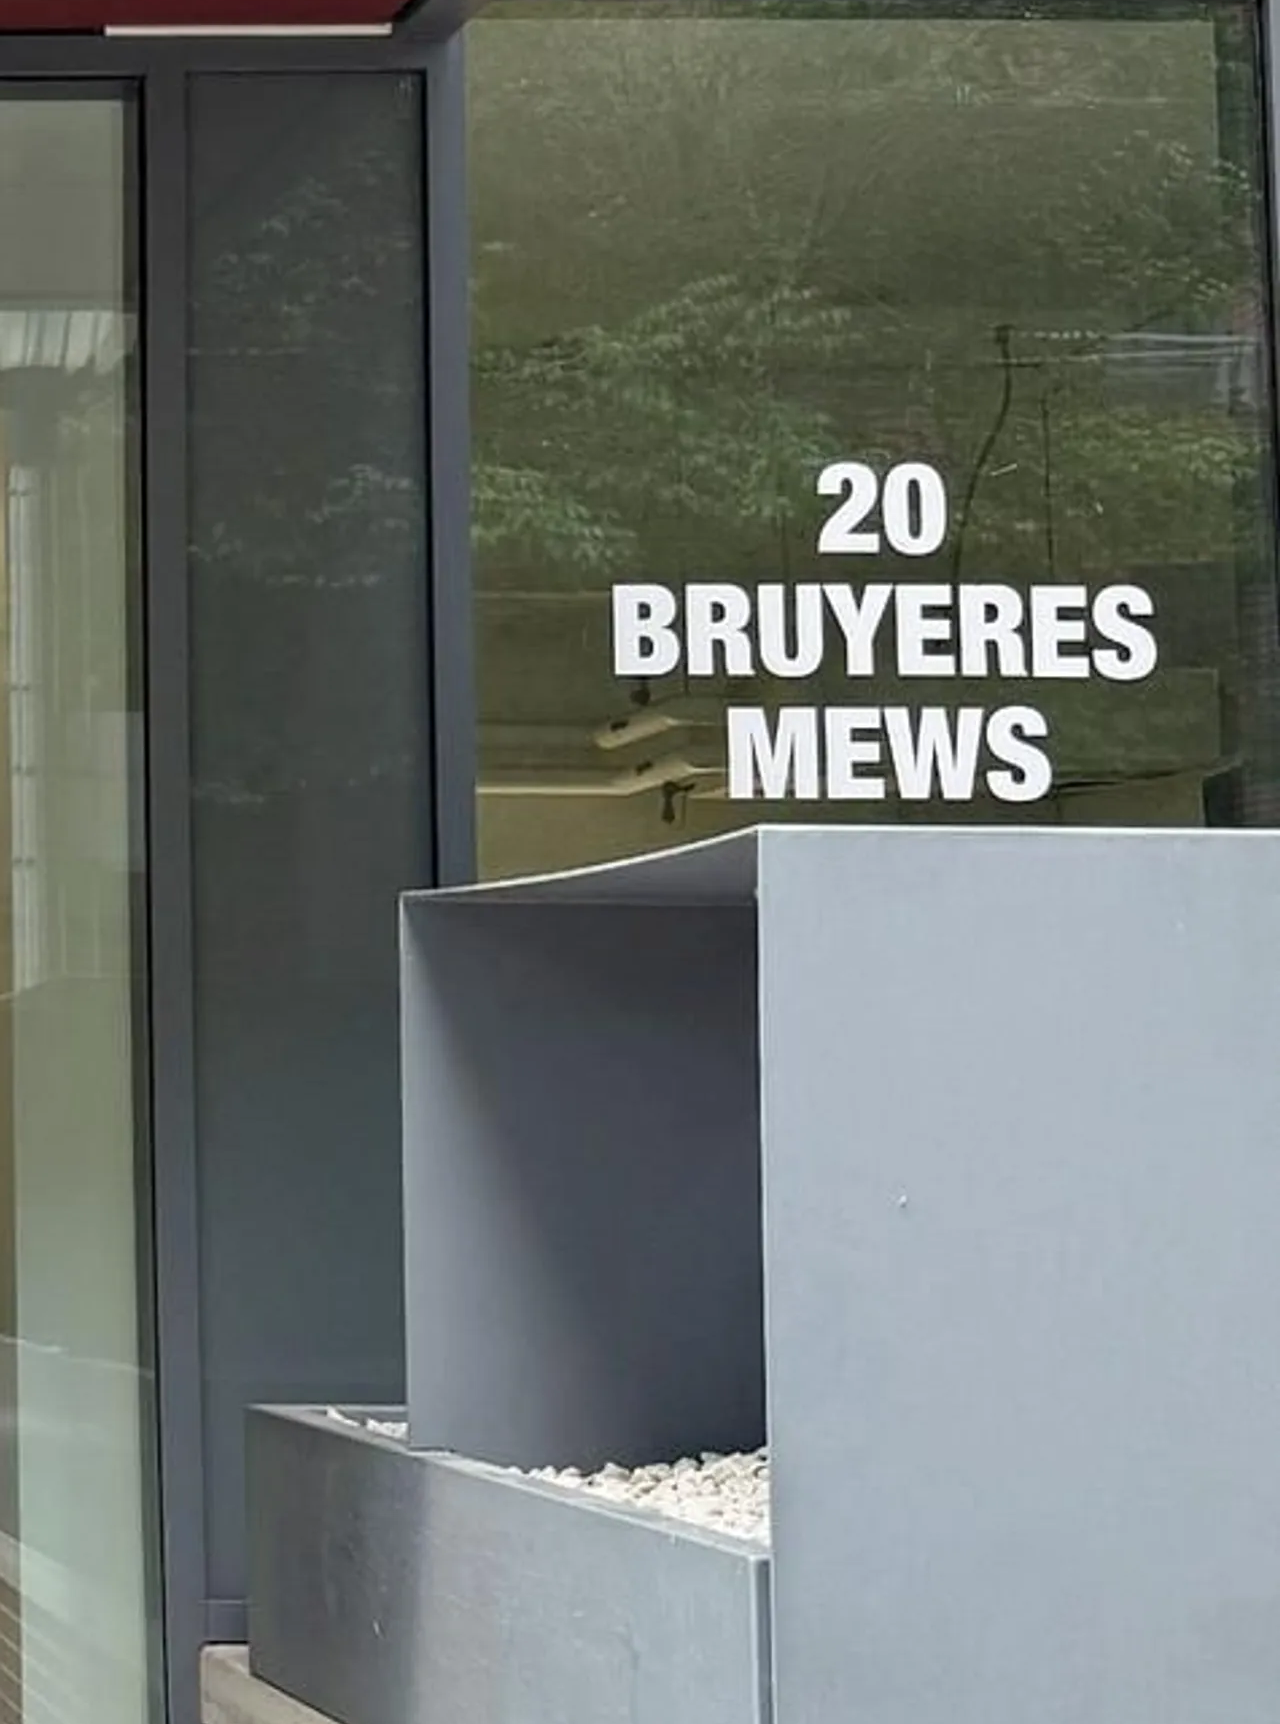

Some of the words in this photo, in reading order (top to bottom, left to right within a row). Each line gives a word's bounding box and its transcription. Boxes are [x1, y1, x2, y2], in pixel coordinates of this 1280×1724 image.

[816, 462, 948, 557] 20
[611, 582, 1159, 681] BRUYERES
[726, 705, 1054, 803] MEWS
